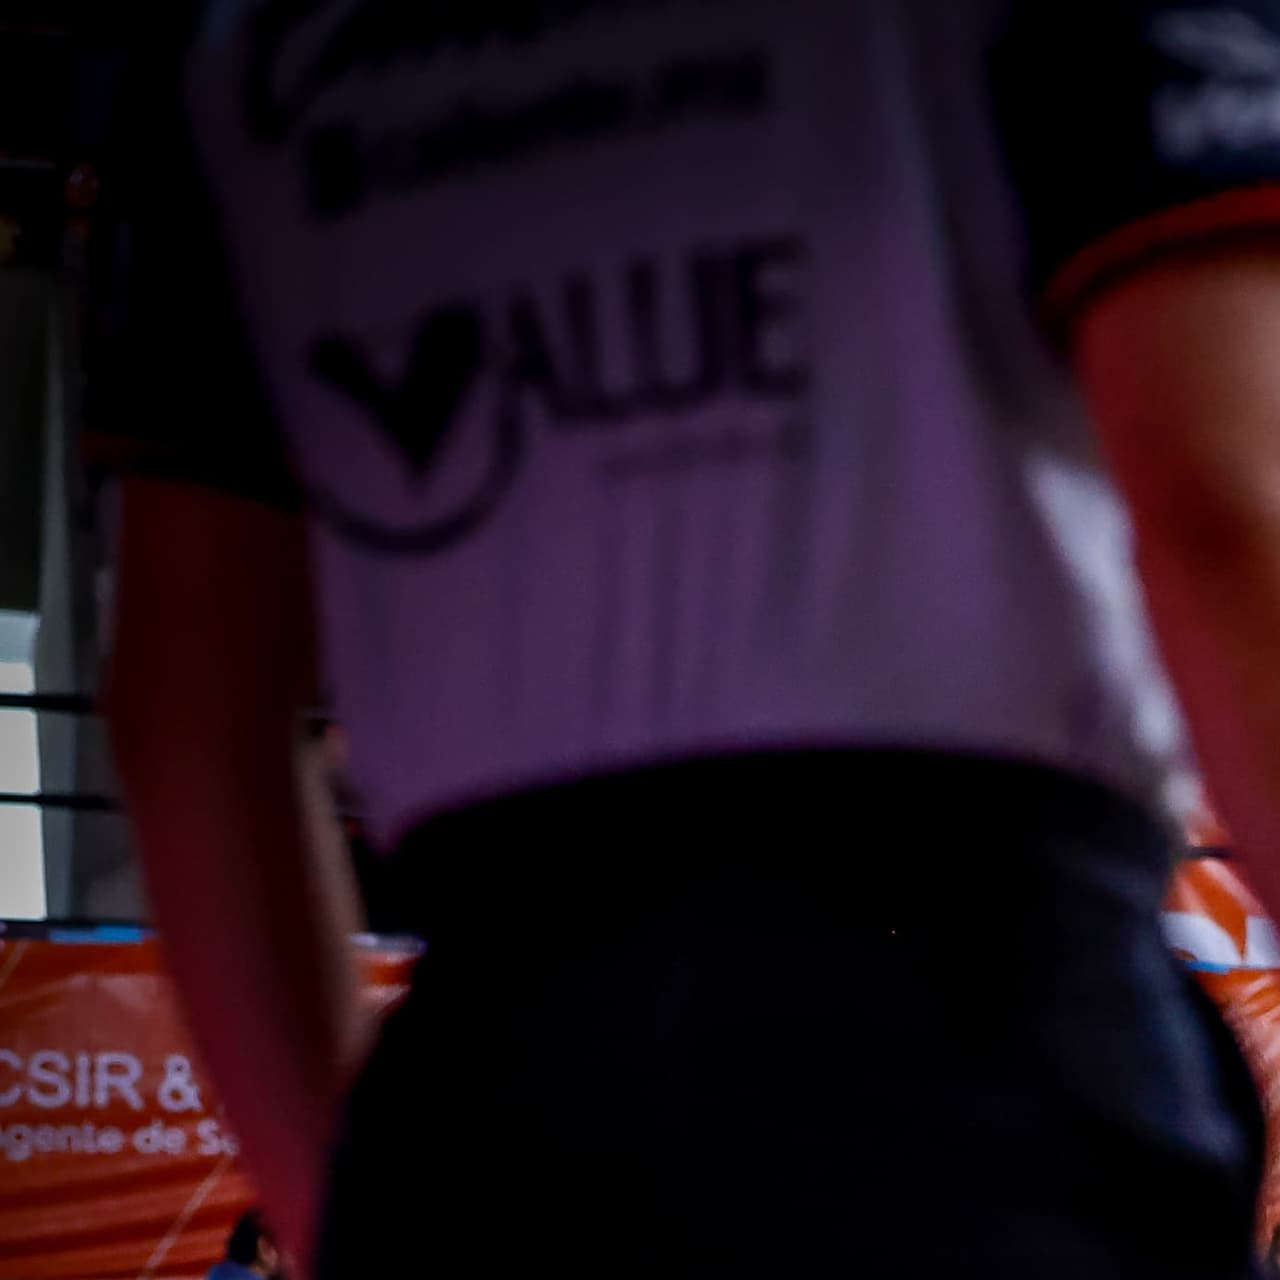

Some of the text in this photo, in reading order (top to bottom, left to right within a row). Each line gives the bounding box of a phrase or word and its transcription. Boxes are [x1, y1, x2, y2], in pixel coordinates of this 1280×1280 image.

[156, 1053, 203, 1113] &
[0, 1122, 124, 1161] gente
[131, 1118, 187, 1154] de
